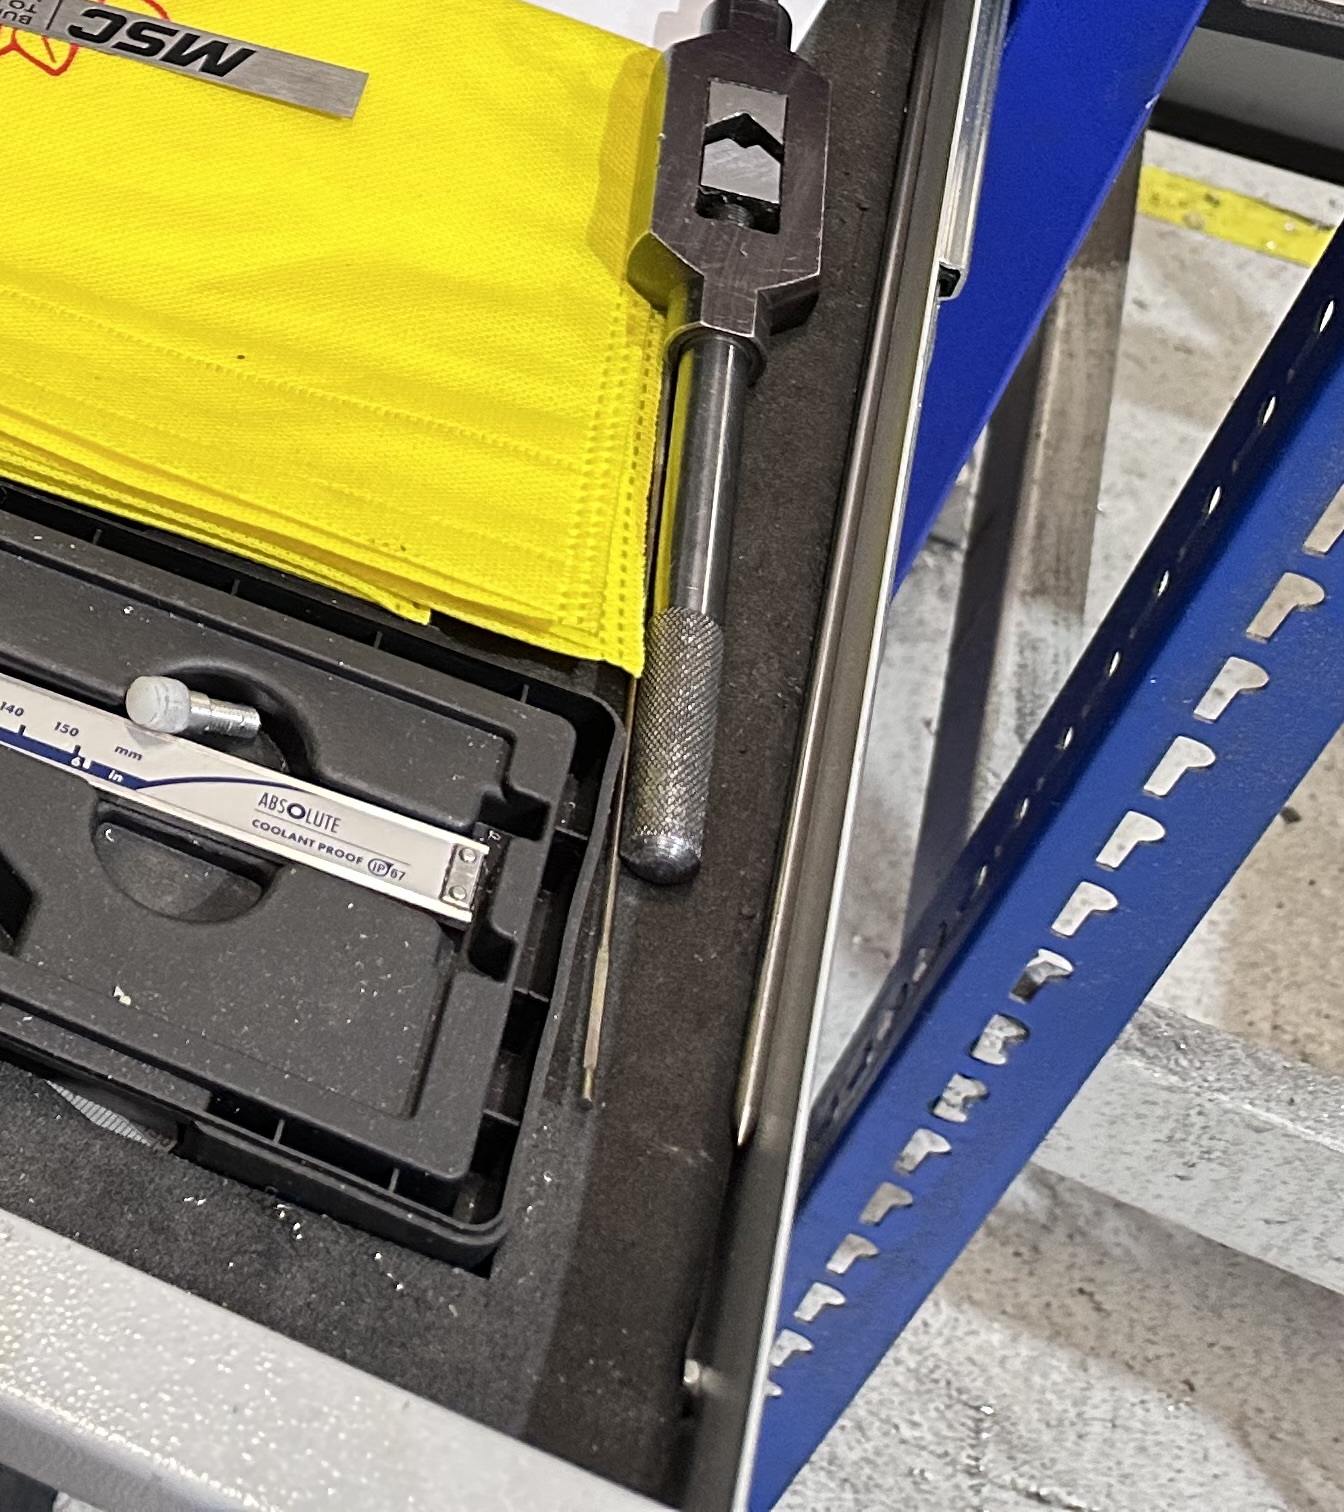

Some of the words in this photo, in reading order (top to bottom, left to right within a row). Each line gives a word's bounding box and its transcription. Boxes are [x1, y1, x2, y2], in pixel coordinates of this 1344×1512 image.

[9, 0, 40, 15] TO
[67, 6, 258, 78] MSC
[0, 701, 26, 718] 140
[53, 721, 80, 738] 150
[113, 744, 143, 762] mm
[70, 754, 83, 768] 6
[108, 770, 124, 783] in
[258, 791, 342, 834] ABSOLUTE
[251, 818, 316, 848] COOLANT
[317, 842, 365, 865] PROOF
